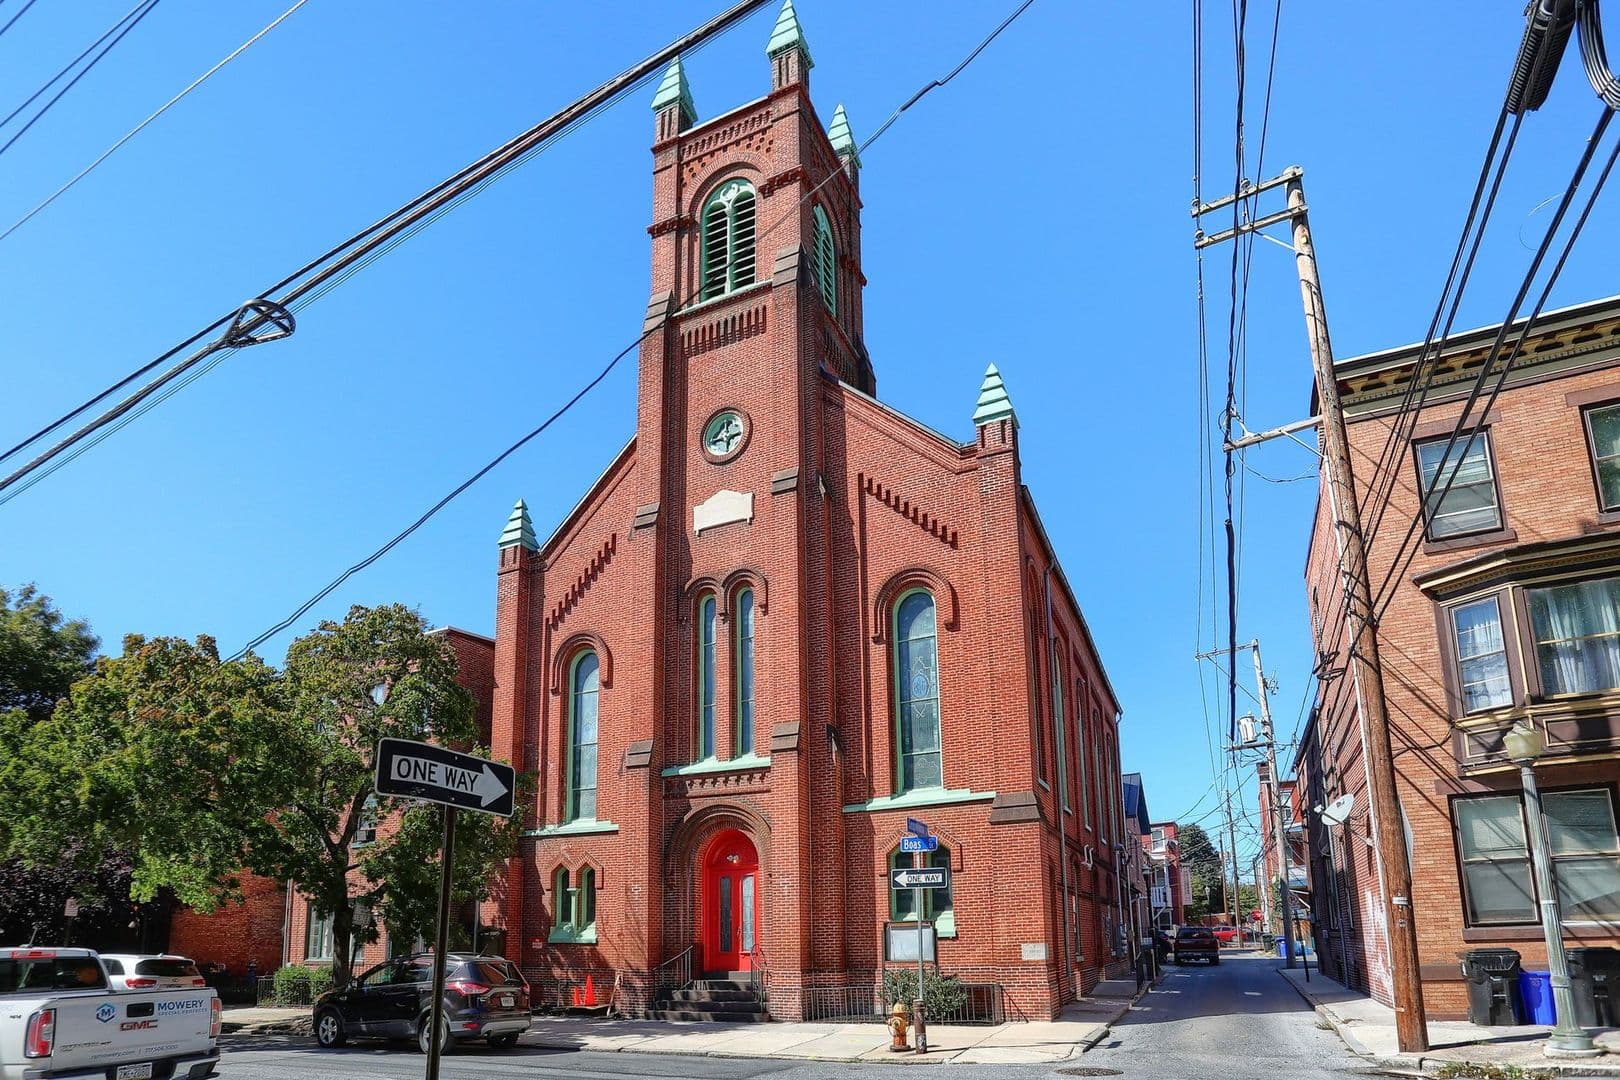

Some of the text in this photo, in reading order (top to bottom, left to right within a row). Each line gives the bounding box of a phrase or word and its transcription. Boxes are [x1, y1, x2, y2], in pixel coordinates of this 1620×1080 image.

[397, 758, 479, 792] ONE WAY
[904, 839, 922, 850] Boas
[907, 874, 940, 883] ONE WAY
[158, 1000, 204, 1011] MOWERY
[120, 1019, 158, 1031] GMC
